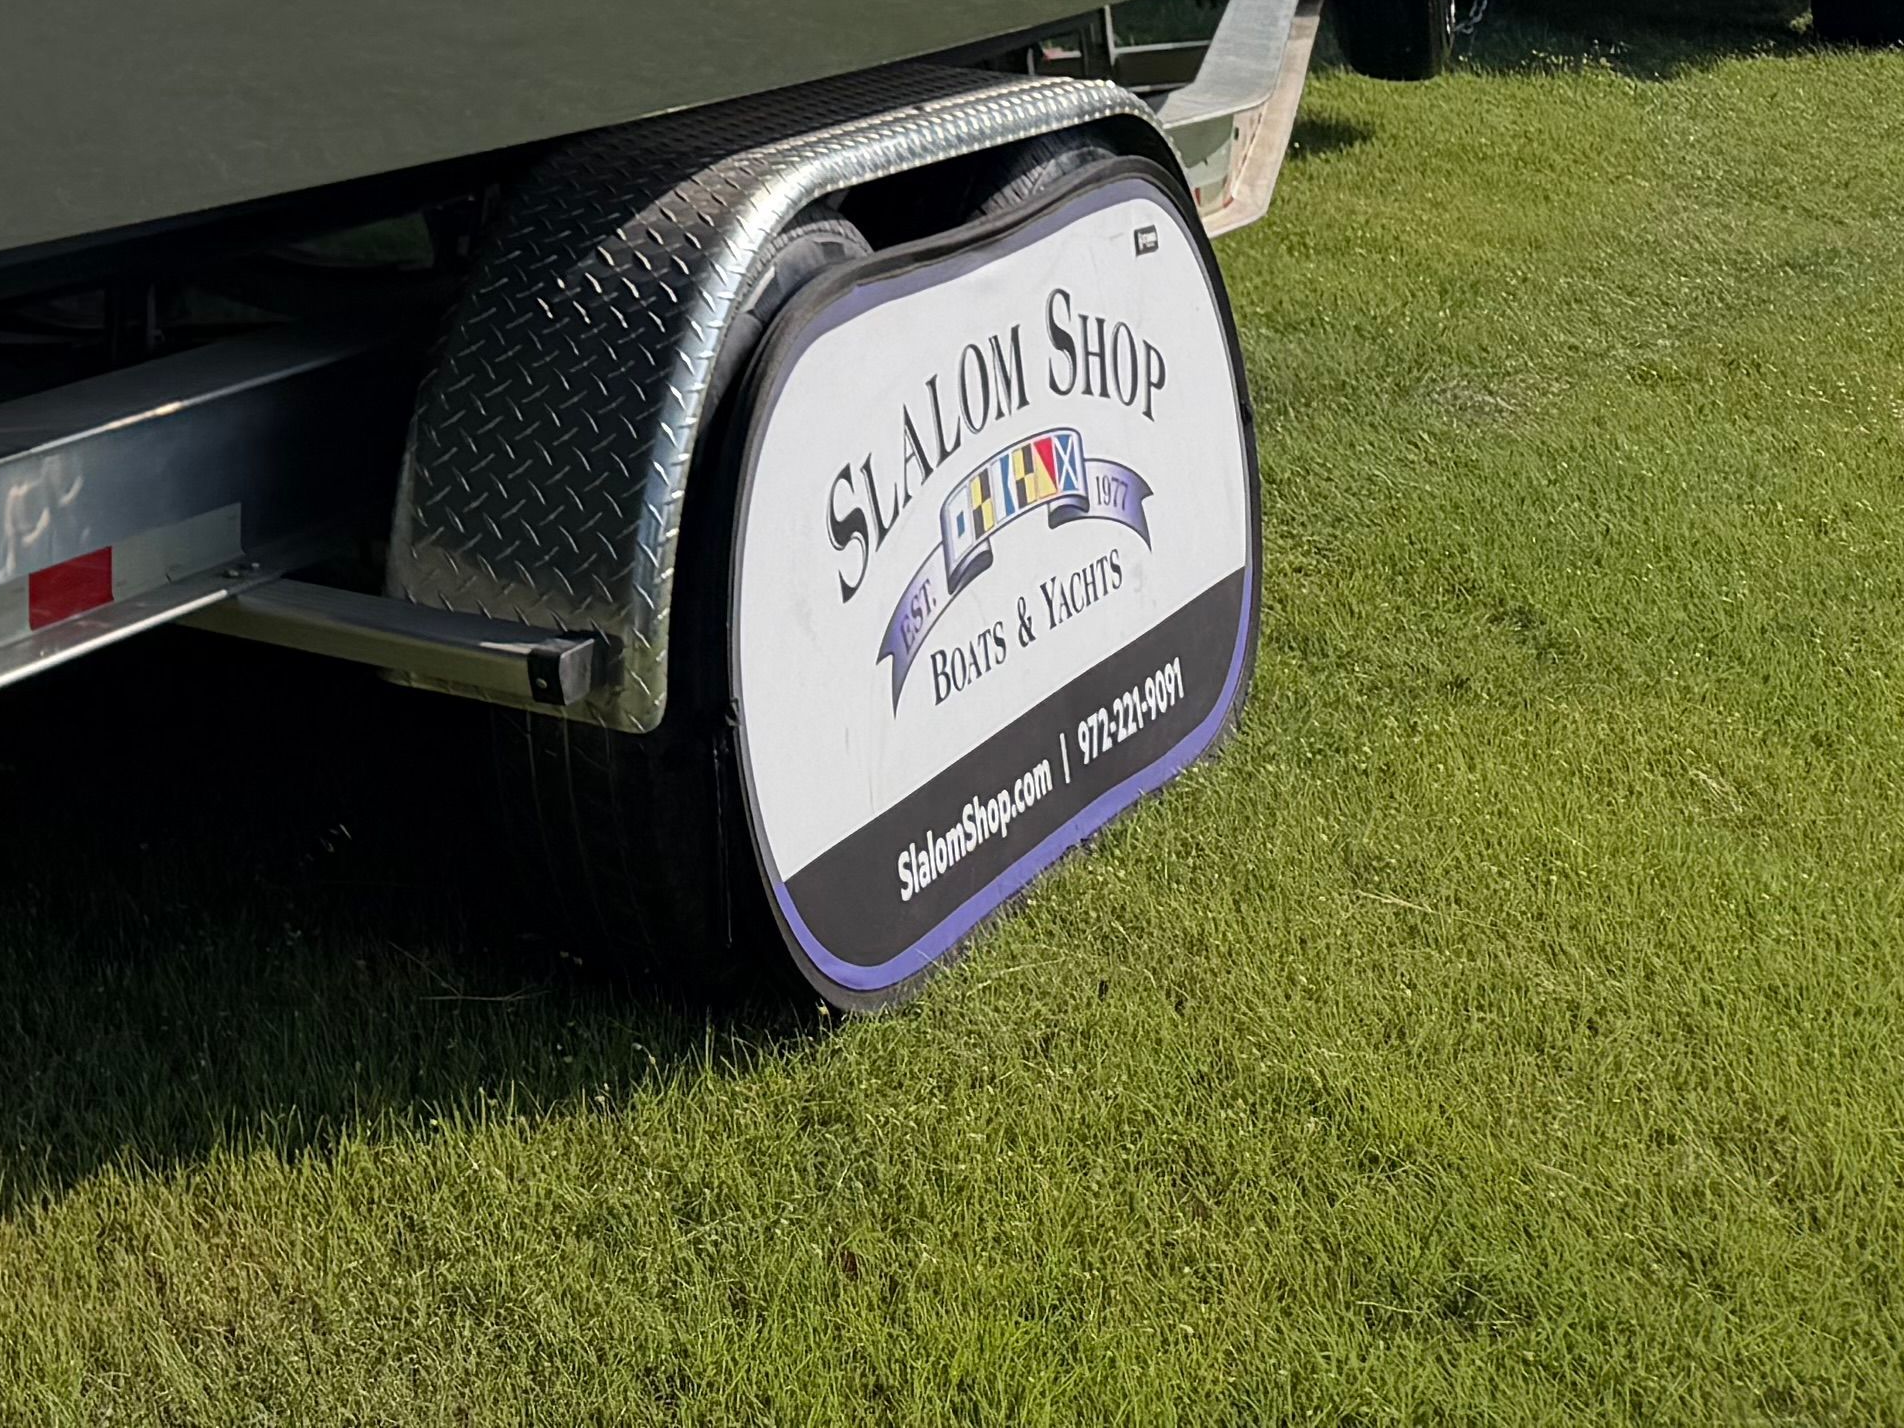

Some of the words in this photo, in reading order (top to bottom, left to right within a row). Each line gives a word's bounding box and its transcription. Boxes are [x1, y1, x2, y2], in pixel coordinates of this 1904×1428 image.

[826, 324, 1031, 604] SLALOM
[1045, 288, 1167, 422] SHOP
[900, 577, 938, 656] EST.
[1095, 475, 1129, 511] 1977
[930, 621, 1007, 706] BOATS
[1017, 596, 1036, 648] &
[1040, 548, 1123, 631] YACHTS
[897, 758, 1054, 902] SlalomShop.com
[1078, 656, 1185, 765] 972-221-9091
